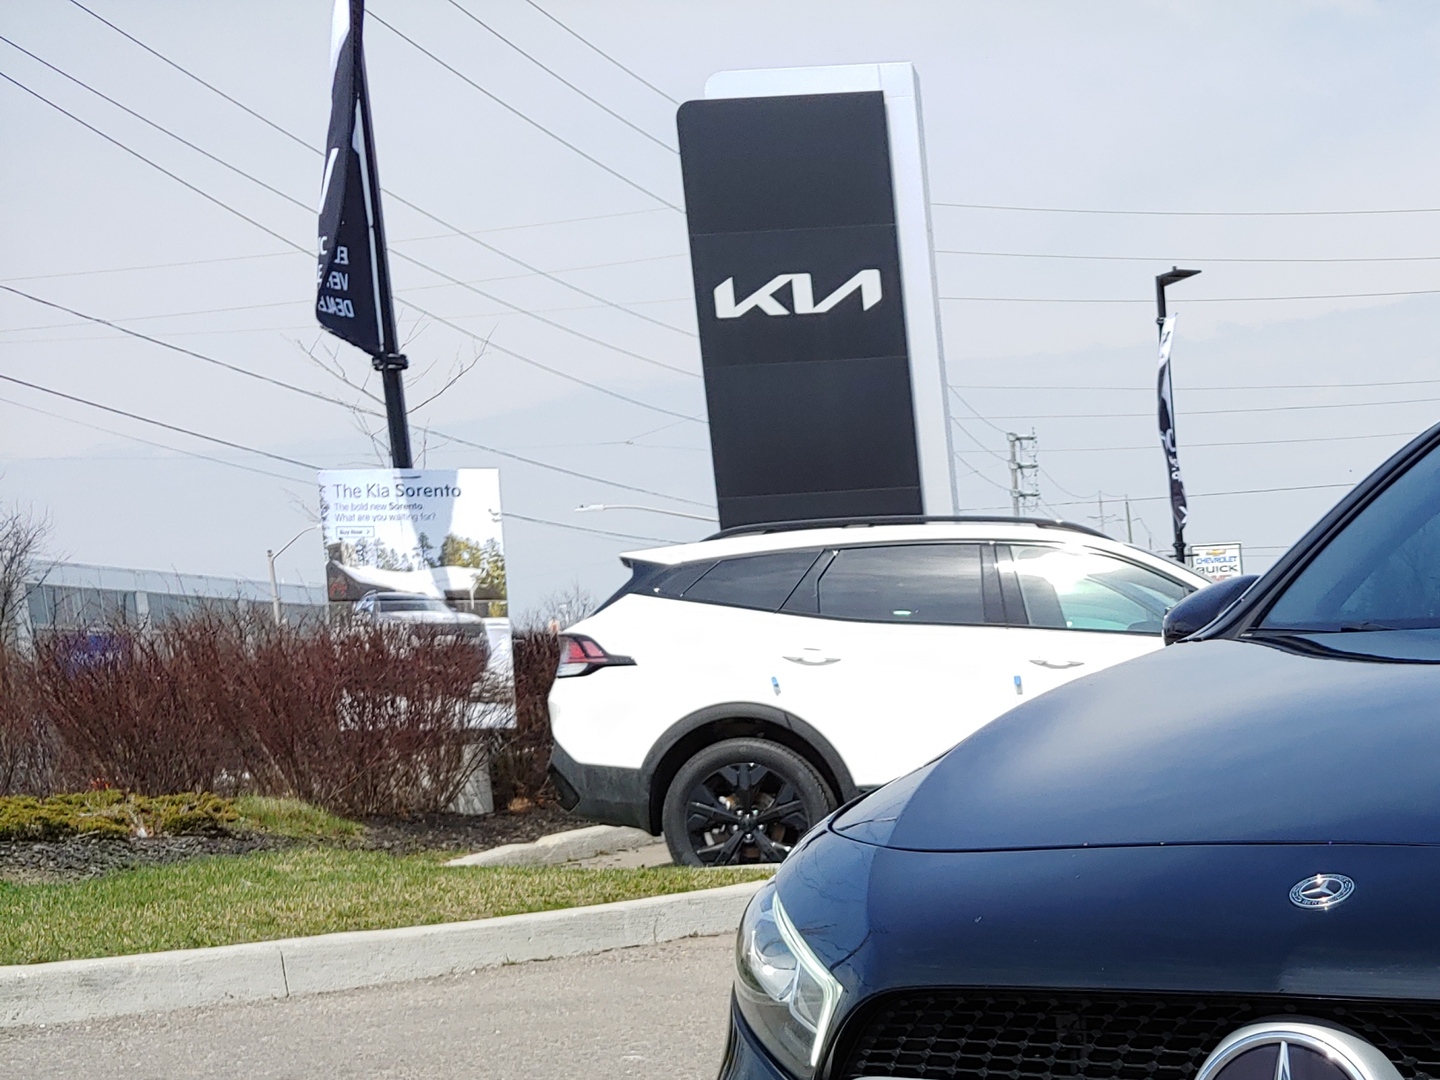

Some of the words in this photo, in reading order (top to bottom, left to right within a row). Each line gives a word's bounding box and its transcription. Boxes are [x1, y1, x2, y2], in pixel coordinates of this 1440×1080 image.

[713, 268, 883, 319] KIA
[333, 483, 362, 499] The
[366, 482, 390, 499] Kia
[396, 483, 462, 499] Sorento
[335, 502, 349, 511] The
[351, 502, 369, 511] bold
[389, 502, 423, 511] Sorento
[335, 513, 356, 522] What
[372, 514, 387, 522] you
[1196, 556, 1237, 564] CHEVROLET
[1196, 565, 1238, 574] BUICK
